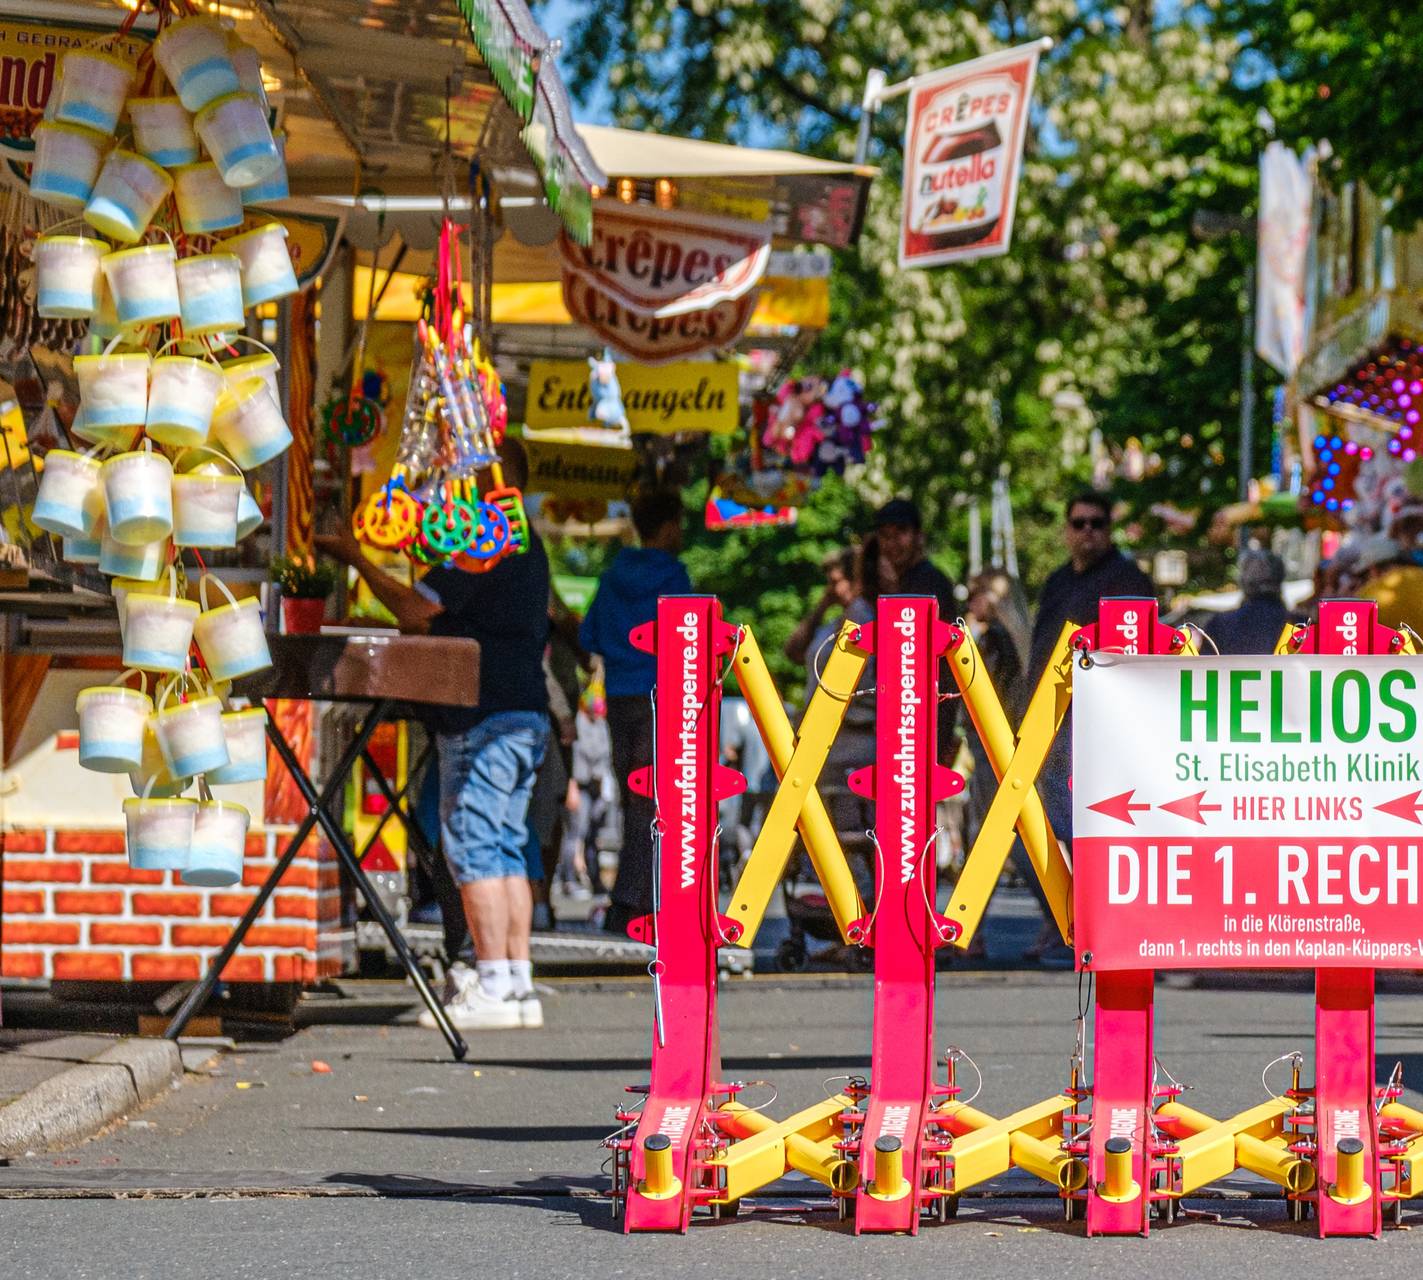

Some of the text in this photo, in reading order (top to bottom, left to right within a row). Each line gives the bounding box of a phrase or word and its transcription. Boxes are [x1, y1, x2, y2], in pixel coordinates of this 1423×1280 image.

[925, 92, 1010, 132] CRÊPES
[920, 151, 995, 195] nutella
[538, 375, 725, 420] Entangeln
[1179, 669, 1418, 744] HELIOS
[675, 612, 702, 888] www.zufahrtssperre.de
[894, 608, 921, 883] www.zufahrtssperre.de
[1175, 751, 1420, 783] St. Elisabeth Klinik
[1233, 796, 1363, 821] HIER LINKS
[1108, 845, 1193, 905] DIE
[1214, 845, 1257, 905] 1.
[1224, 914, 1365, 935] in die Klörenstraße,
[1139, 939, 1175, 957] dann
[1180, 939, 1192, 957] 1.
[1197, 938, 1243, 957] rechts
[1247, 939, 1260, 957] in
[1265, 939, 1291, 957] den
